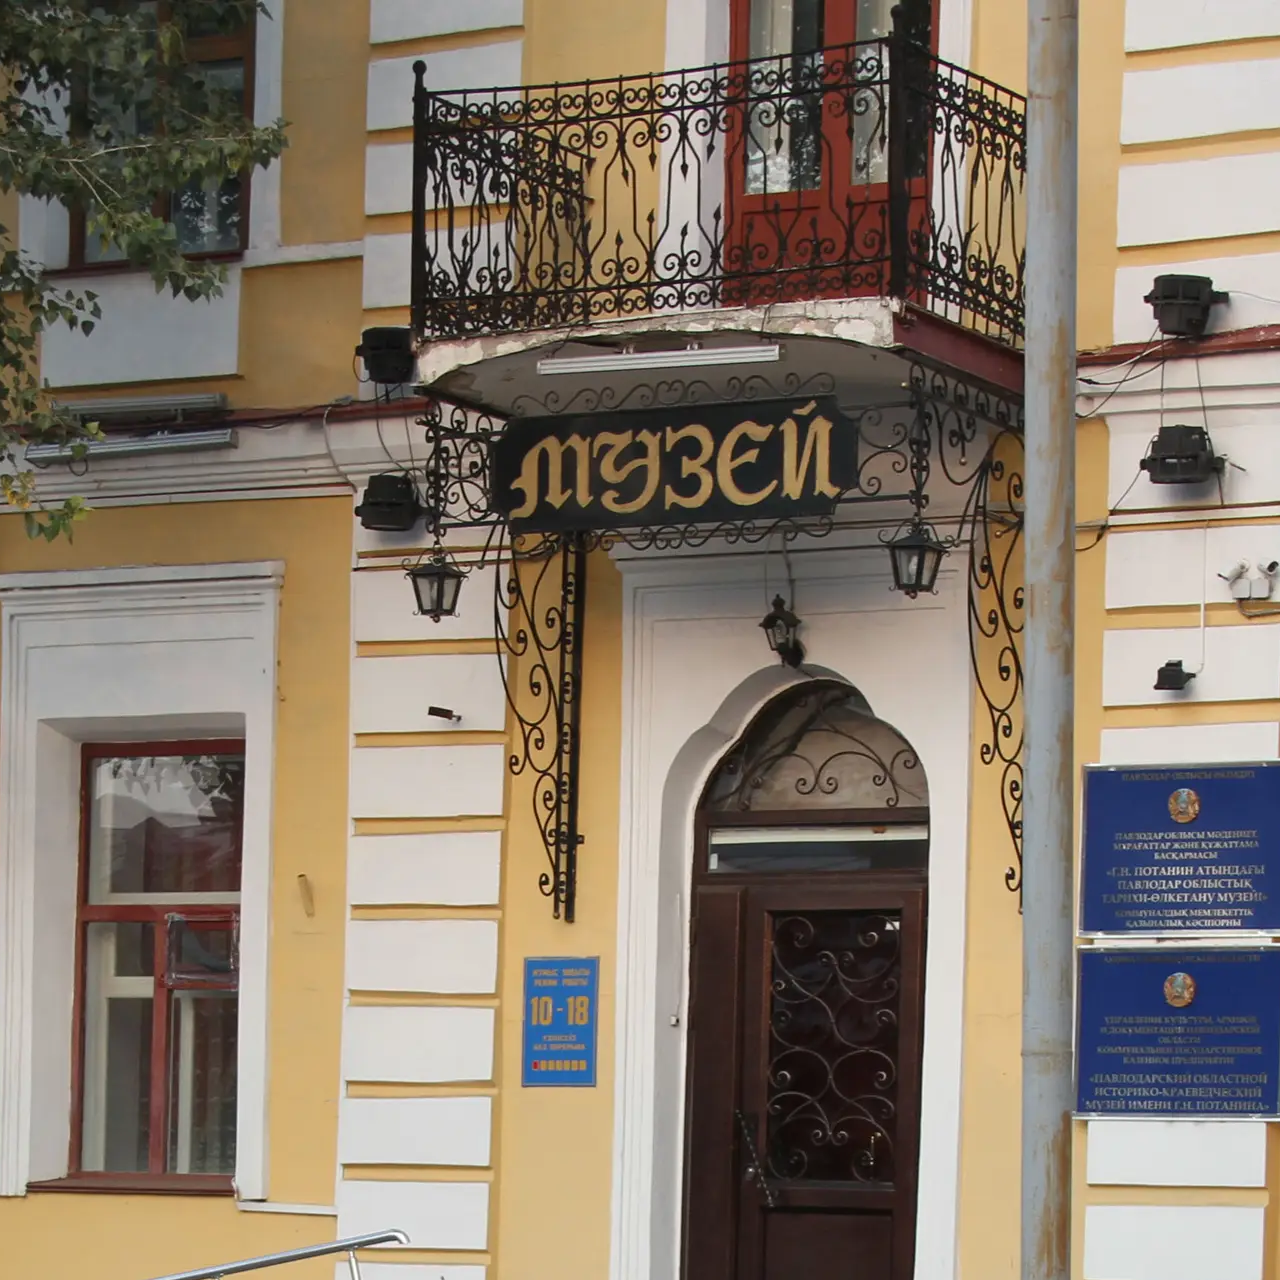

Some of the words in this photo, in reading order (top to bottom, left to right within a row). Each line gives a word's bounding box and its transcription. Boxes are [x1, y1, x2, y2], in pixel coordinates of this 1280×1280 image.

[509, 400, 841, 520] МУЗЕЙ
[1172, 841, 1200, 850] ЖӘНЕ
[1154, 851, 1218, 861] БАСҚАРМАСЫ
[1134, 866, 1194, 876] ПОТАНИН
[1195, 864, 1265, 876] АТЫНДАҒЫ
[1117, 879, 1182, 890] ПАВЛОДАР
[1182, 878, 1254, 891] ОБЛЫСТЫҚ
[531, 995, 554, 1026] 10
[566, 995, 590, 1026] 18
[1089, 1072, 1192, 1085] «ПАВЛОДАРСКИЙ
[1193, 1071, 1268, 1084] ОБЛАСТНОЙ
[1094, 1085, 1262, 1098] ИСТОРИКО-КРАЕВЕДЧЕСКИЙ
[1084, 1098, 1126, 1110] МУЗЕЙ
[1127, 1099, 1173, 1110] ИМЕНИ
